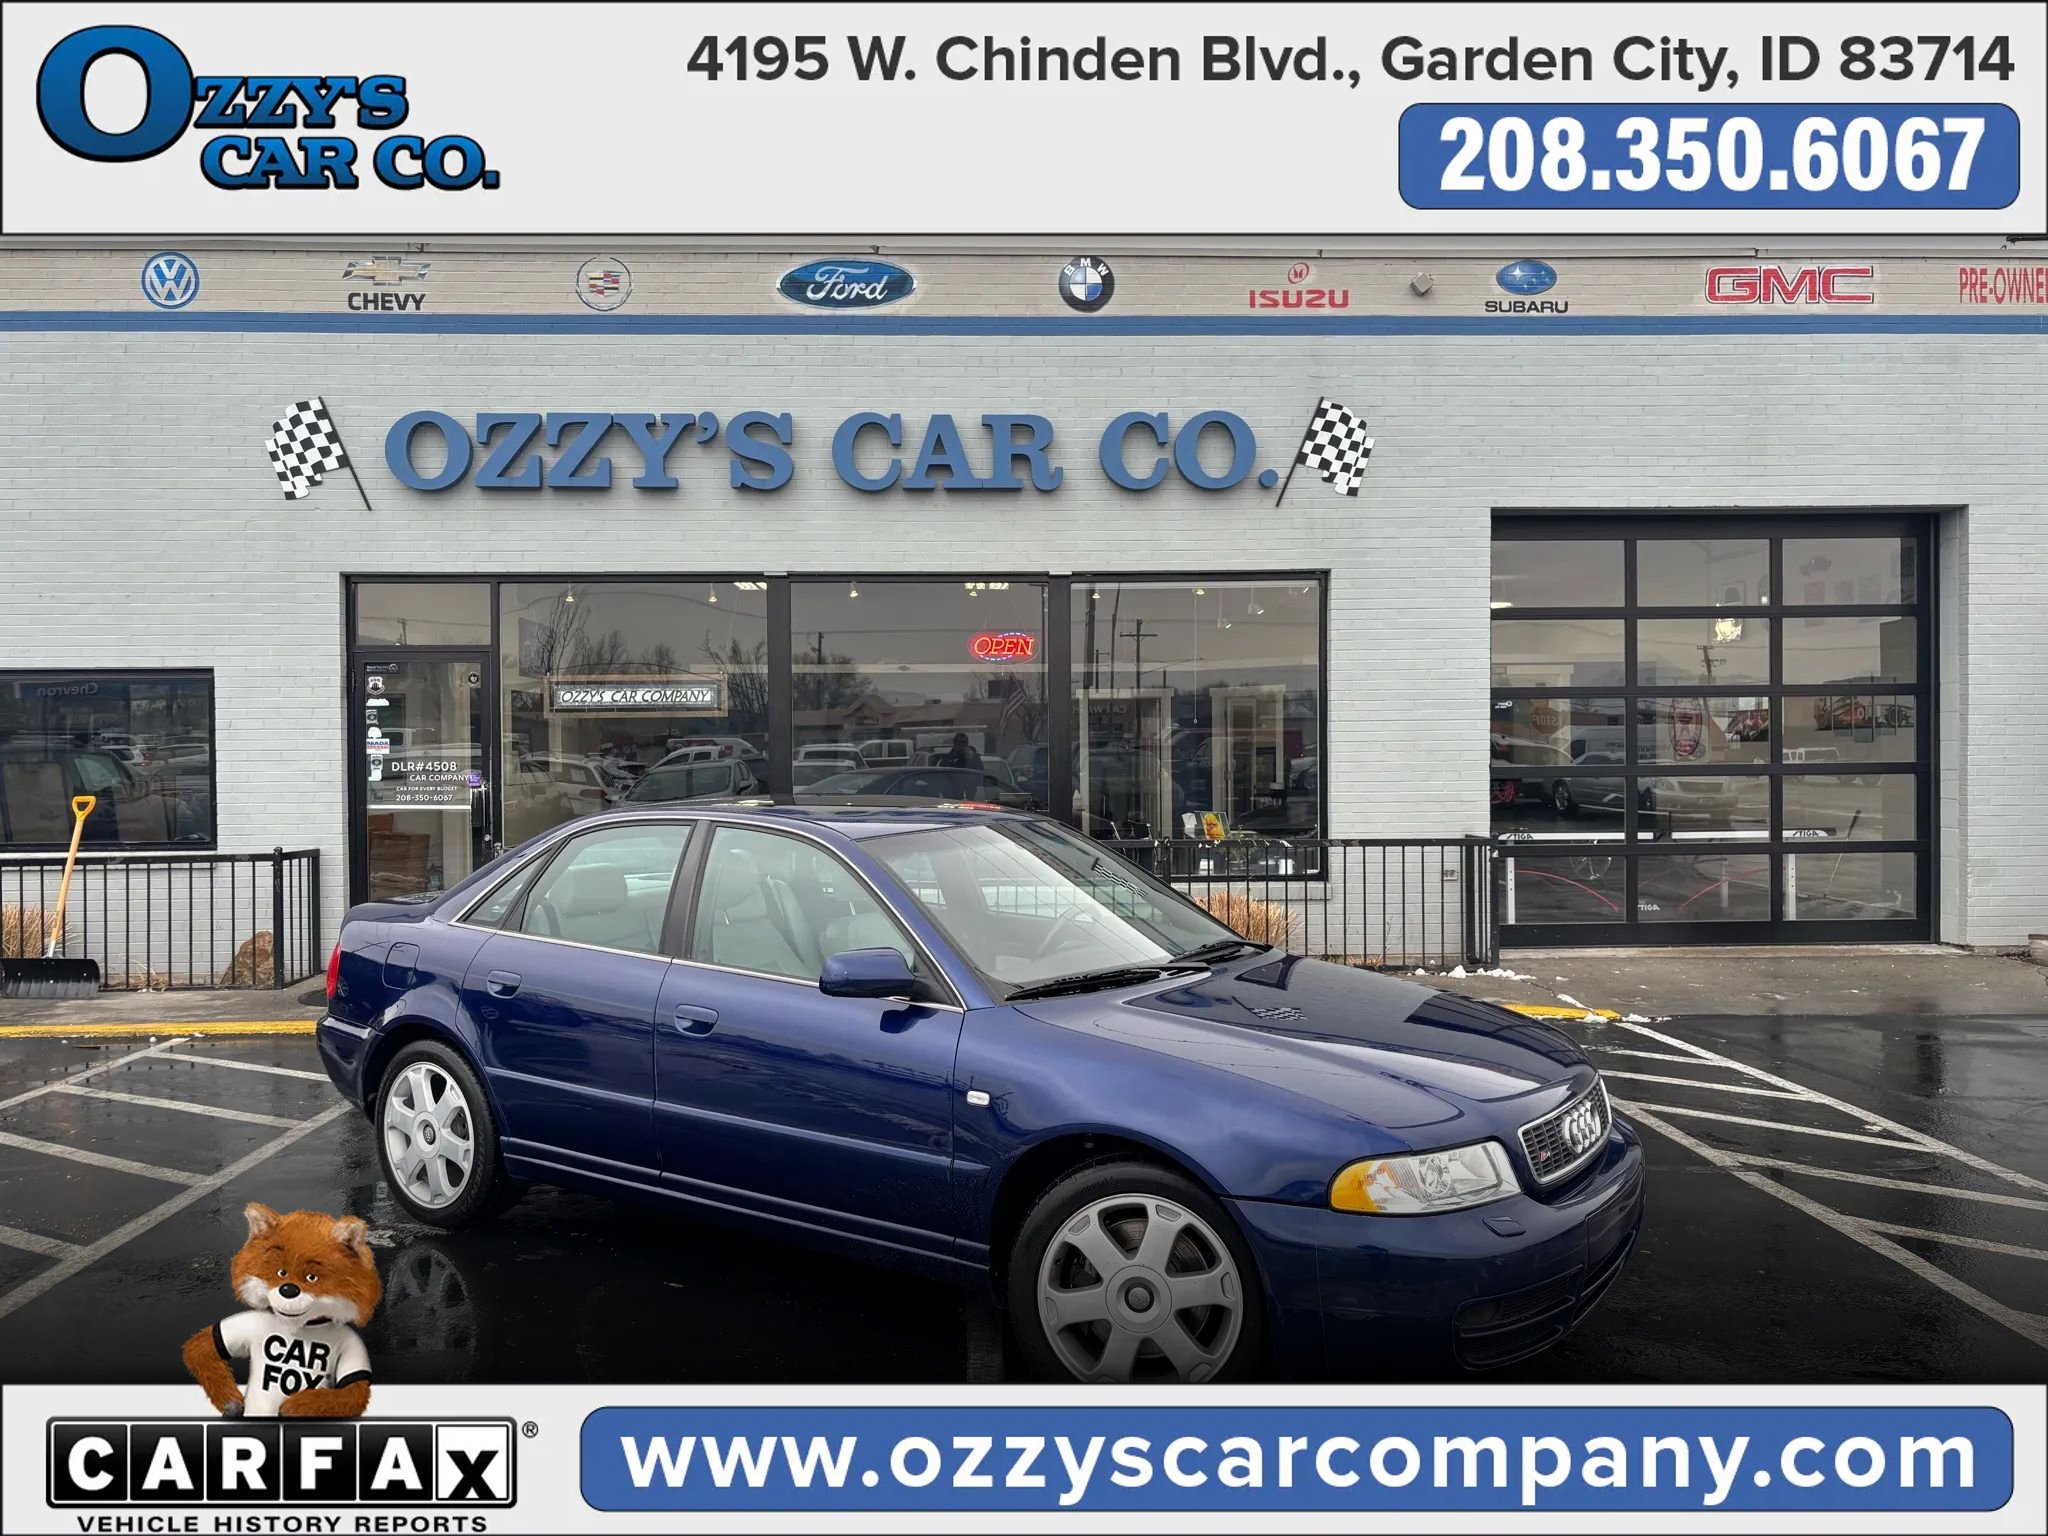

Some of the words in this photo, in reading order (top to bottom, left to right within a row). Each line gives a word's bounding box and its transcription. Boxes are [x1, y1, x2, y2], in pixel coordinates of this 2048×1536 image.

[1064, 257, 1110, 276] BMW
[806, 266, 888, 302] Ford
[1704, 265, 1875, 305] GMC
[1959, 267, 2048, 304] PRE-OWNE
[347, 292, 427, 312] CHEVY
[1249, 289, 1349, 309] ISUZU
[1484, 300, 1569, 314] SUBARU
[385, 410, 794, 492] OZZY'S
[832, 411, 1064, 492] CAR
[1100, 410, 1279, 491] CO.
[974, 637, 1034, 656] OPEN
[561, 690, 605, 703] OZZY'S
[611, 690, 637, 703] CAR
[641, 690, 711, 703] COMPANY
[391, 761, 458, 771] DLR#4508
